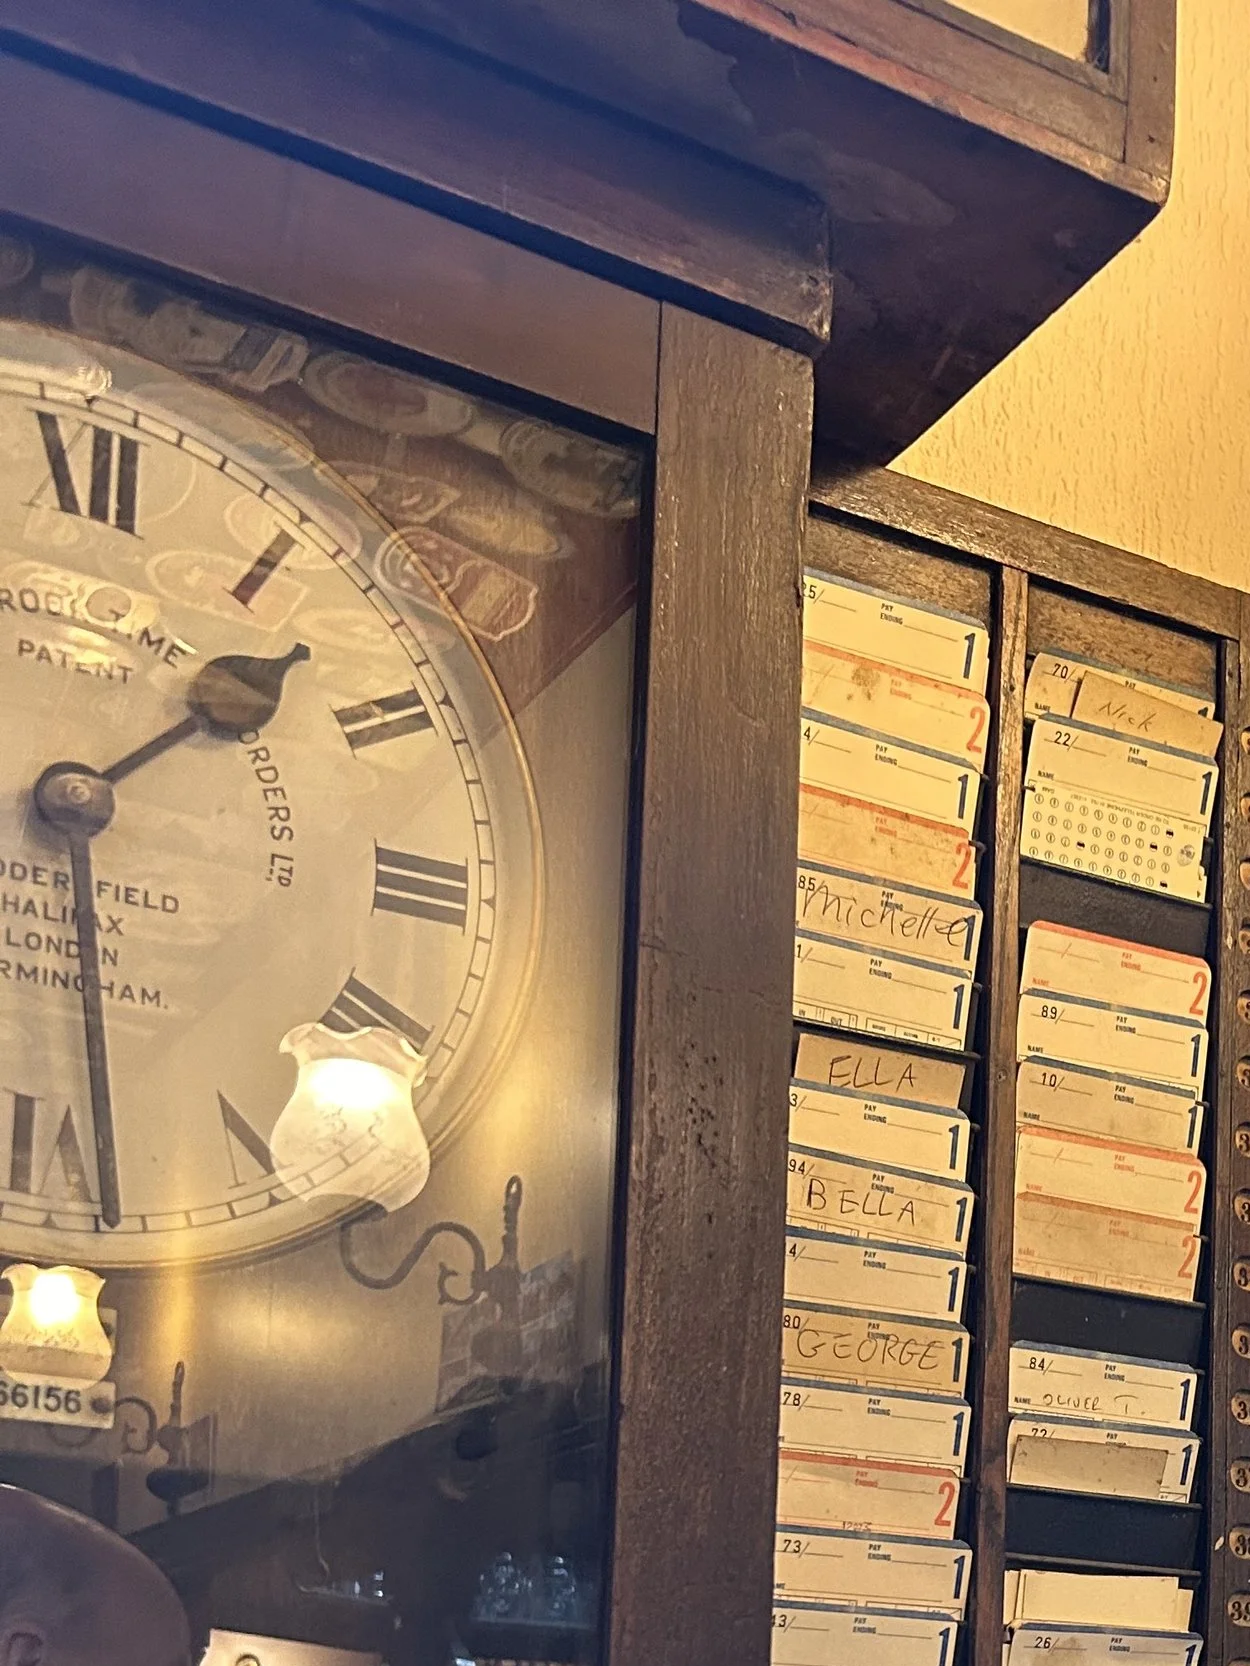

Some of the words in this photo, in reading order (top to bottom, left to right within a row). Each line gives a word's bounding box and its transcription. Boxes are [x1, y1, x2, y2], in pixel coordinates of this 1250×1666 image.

[240, 729, 293, 841] ORDERS
[6, 927, 119, 967] LONDN
[828, 1056, 917, 1092] ELLA
[806, 1178, 916, 1227] BELLA
[797, 1328, 947, 1371] GEORGE
